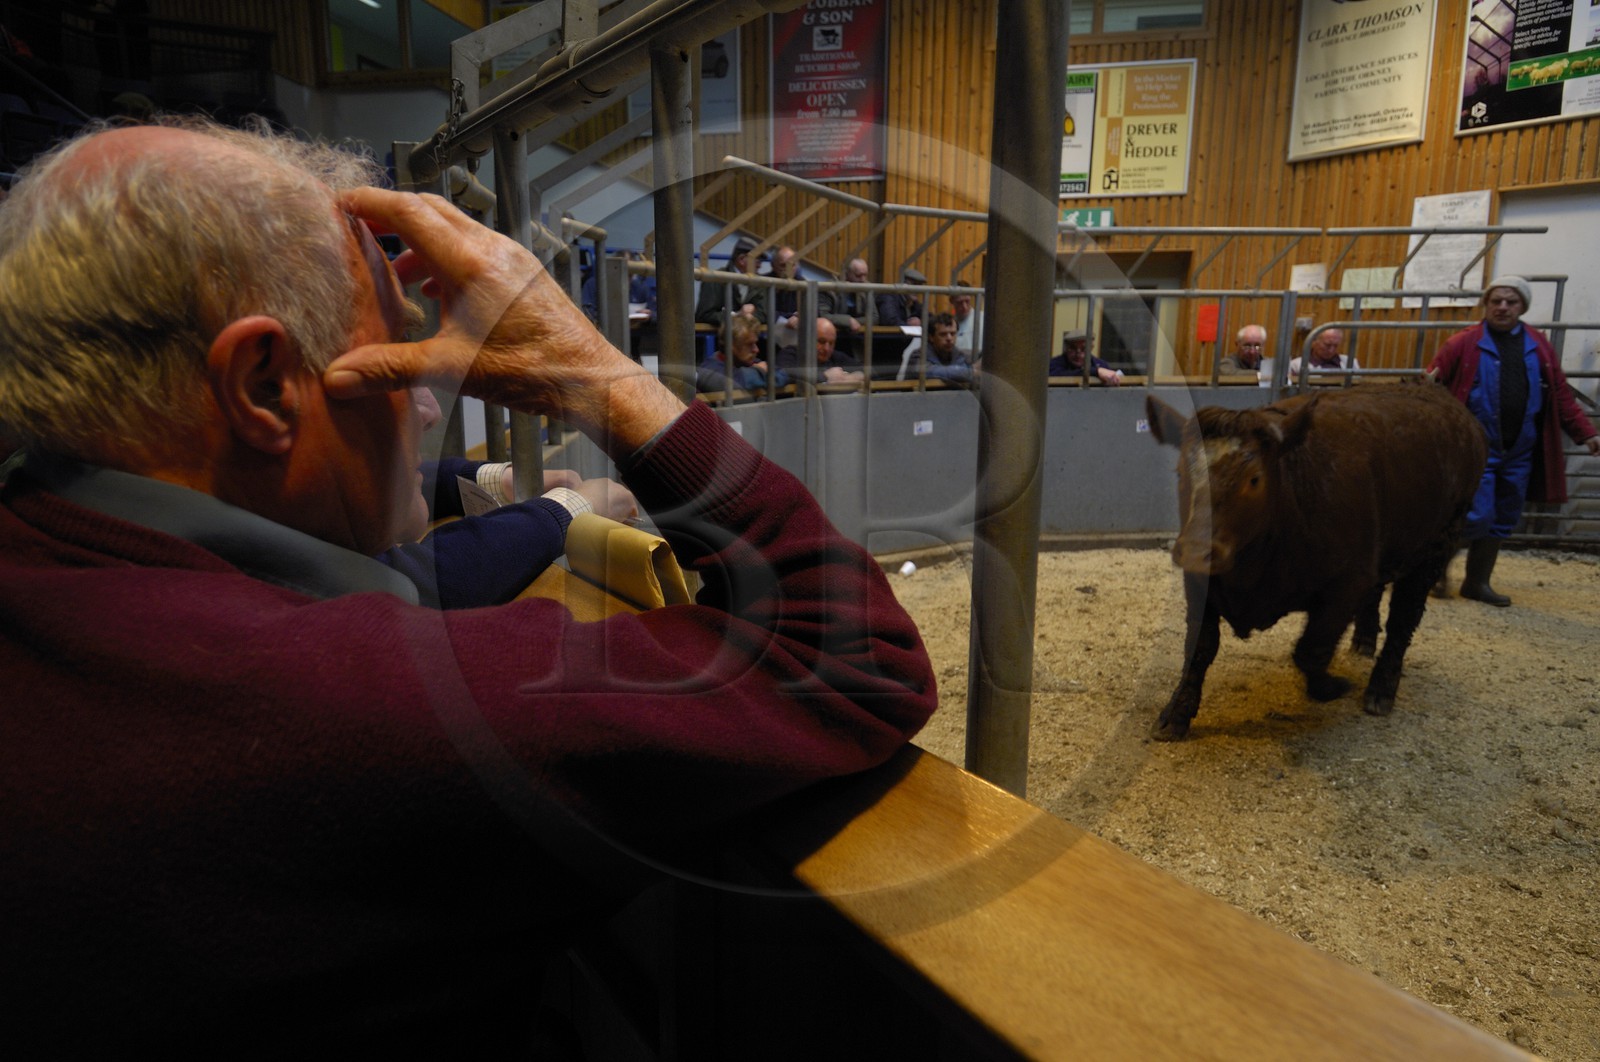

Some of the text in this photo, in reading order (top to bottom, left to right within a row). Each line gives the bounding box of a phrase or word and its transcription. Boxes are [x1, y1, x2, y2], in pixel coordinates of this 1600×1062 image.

[1537, 3, 1547, 11] and
[803, 10, 854, 25] & SON
[1307, 2, 1424, 42] CLARK THOMSON
[1539, 15, 1550, 23] your
[1551, 11, 1571, 20] business
[1390, 21, 1406, 31] LTD
[1514, 26, 1551, 38] Select Services
[1553, 29, 1562, 37] for
[1531, 37, 1559, 46] enterprises
[799, 52, 857, 62] TRADITIONAL
[1305, 53, 1418, 83] LOCAL INSURANCE SERVICES
[1066, 74, 1094, 84] AIRY
[1324, 67, 1392, 88] FOR THE ORKNEY
[788, 79, 866, 92] DELICATESSEN
[1314, 75, 1402, 99] FARMING COMMUNITY
[806, 93, 848, 107] OPEN
[1126, 122, 1178, 136] DREVER
[1125, 136, 1135, 147] &
[1125, 145, 1178, 158] HEDDLE
